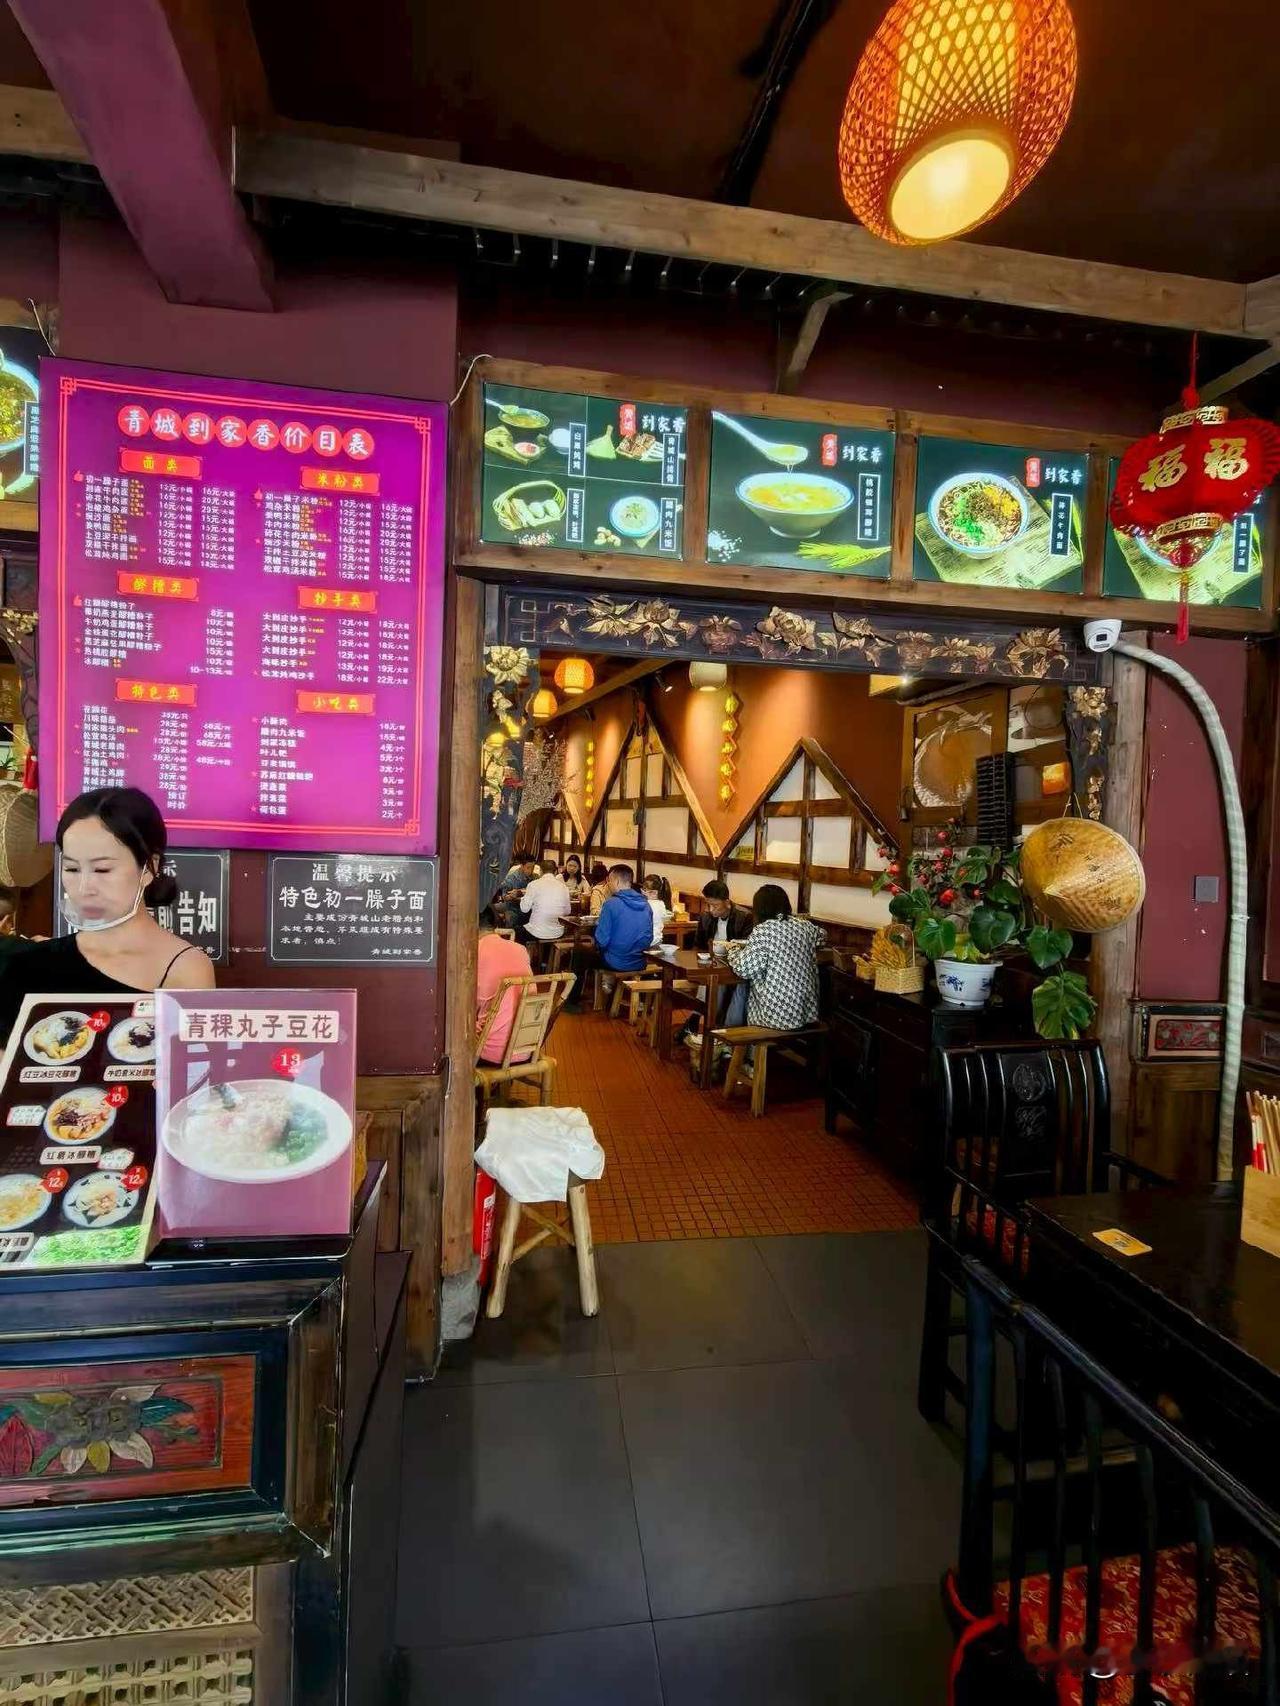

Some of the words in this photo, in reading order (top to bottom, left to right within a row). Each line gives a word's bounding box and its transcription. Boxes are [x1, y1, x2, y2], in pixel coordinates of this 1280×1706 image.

[123, 409, 370, 457] 青城到家香价目表
[641, 414, 686, 433] 到家香
[142, 454, 178, 473] 面类
[842, 445, 882, 464] 到家香
[1138, 443, 1188, 492] 福
[1204, 438, 1248, 480] 福
[317, 470, 364, 491] 米粉类
[1044, 467, 1082, 485] 到家香
[313, 590, 361, 609] 抄手类
[312, 694, 359, 710] 小吃类
[312, 863, 397, 883] 温馨提示
[279, 886, 427, 910] 特色初一臊子面
[186, 1012, 333, 1039] 青稞丸子豆花
[281, 1053, 301, 1067] 13
